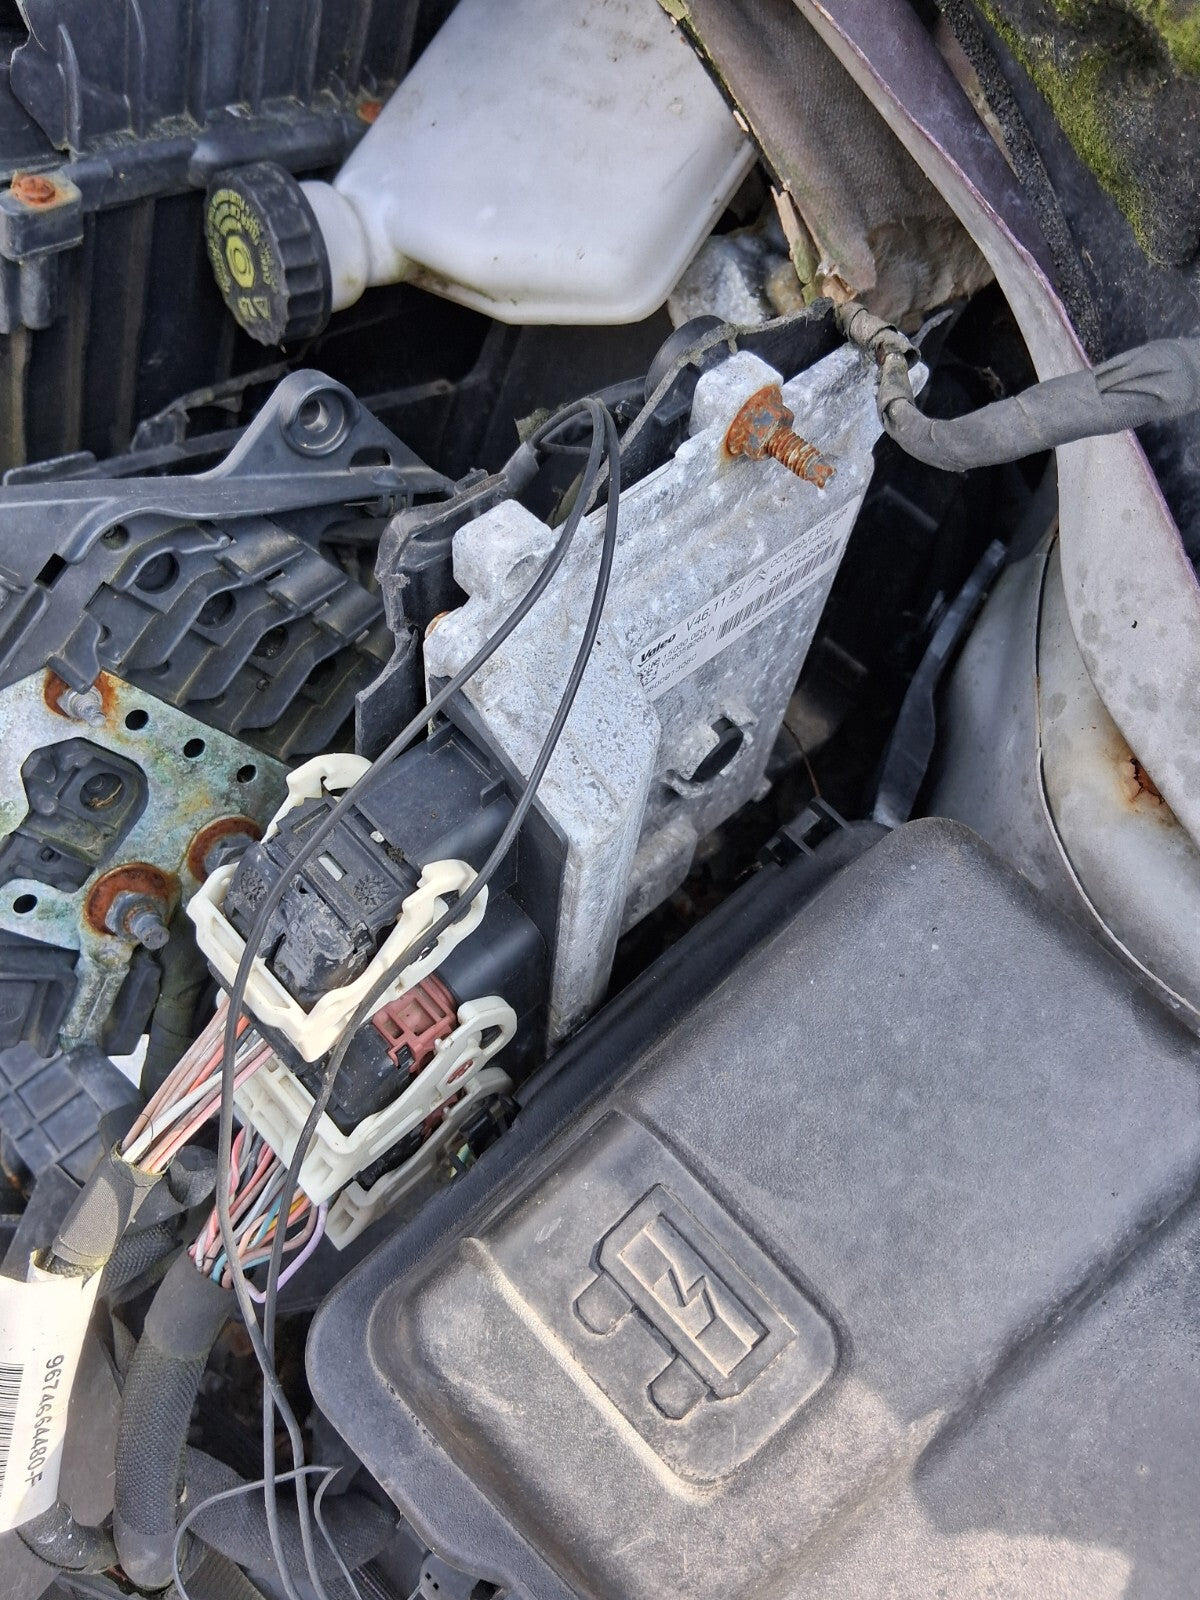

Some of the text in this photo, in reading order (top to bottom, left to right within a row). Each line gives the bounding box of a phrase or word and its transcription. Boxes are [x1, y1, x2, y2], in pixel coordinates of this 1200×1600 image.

[686, 597, 727, 631] V46.11
[639, 633, 677, 665] Valeo
[25, 1354, 64, 1488] 9674664480-F
